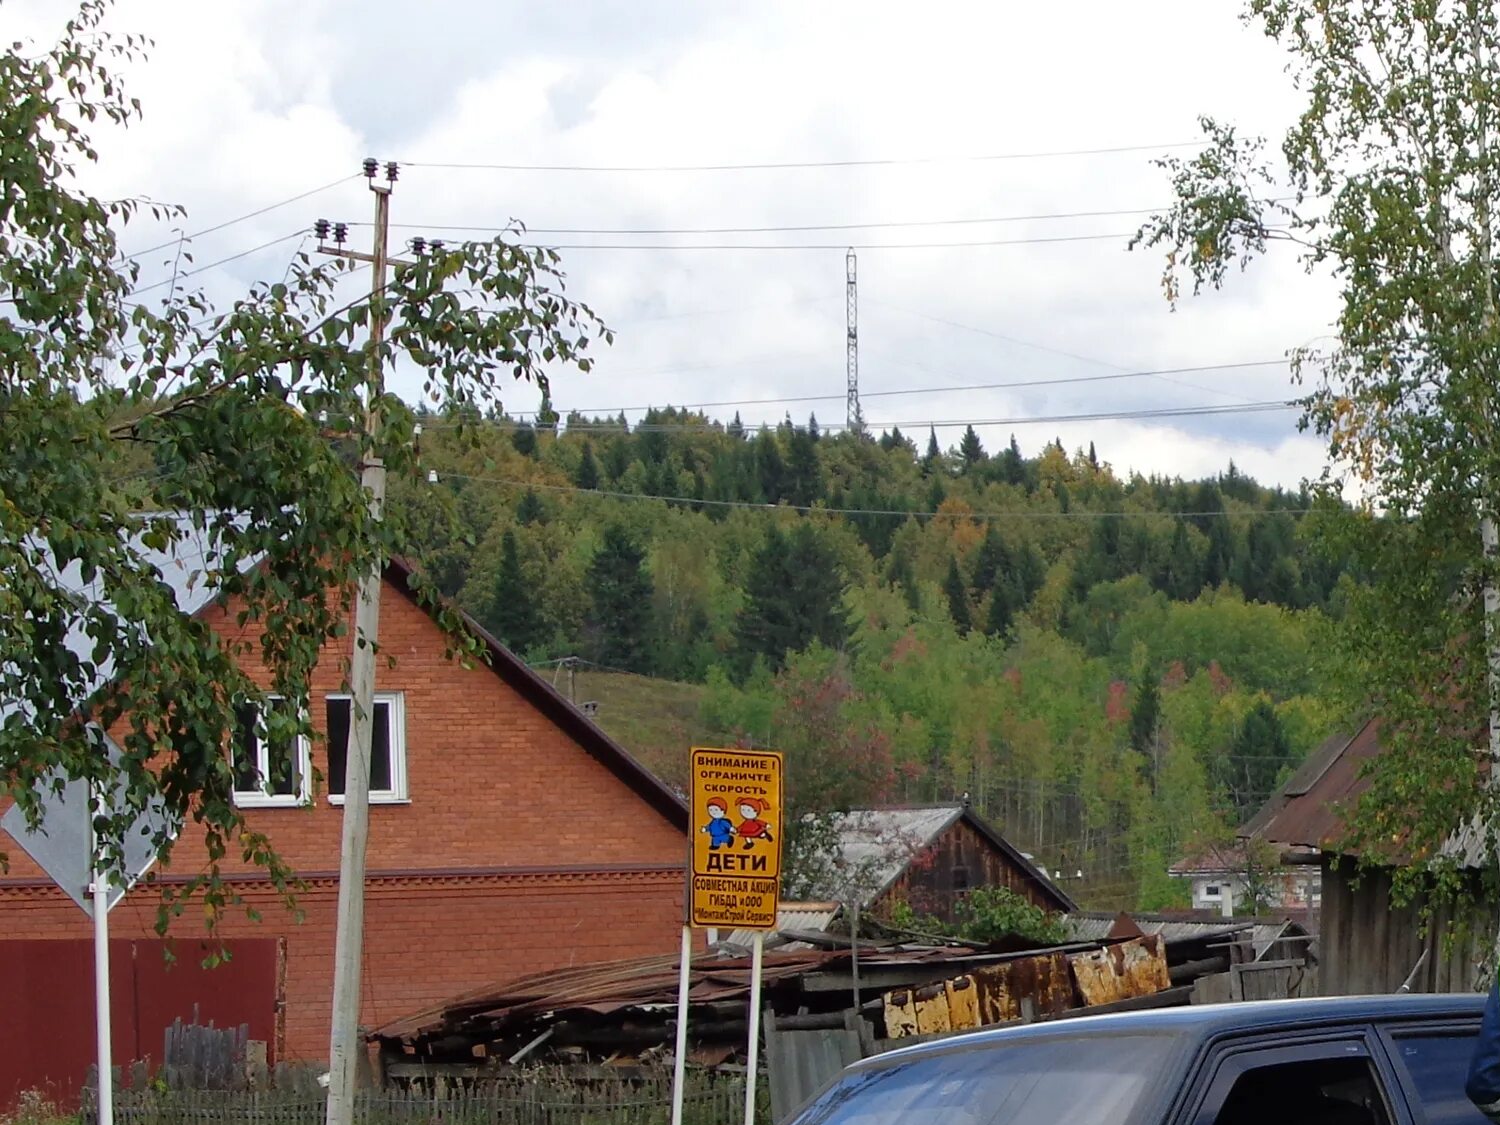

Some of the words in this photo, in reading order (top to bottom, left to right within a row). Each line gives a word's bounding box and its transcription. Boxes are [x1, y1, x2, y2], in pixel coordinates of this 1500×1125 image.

[697, 756, 768, 769] ВНИМАНИЕ
[700, 770, 772, 782] ОГРАНИЧТЕ
[704, 783, 767, 795] СКОРОСТЬ
[706, 853, 767, 872] ДЕТИ
[694, 878, 748, 893] СОВМЕСТНАЯ
[709, 893, 737, 909] ГИБДД
